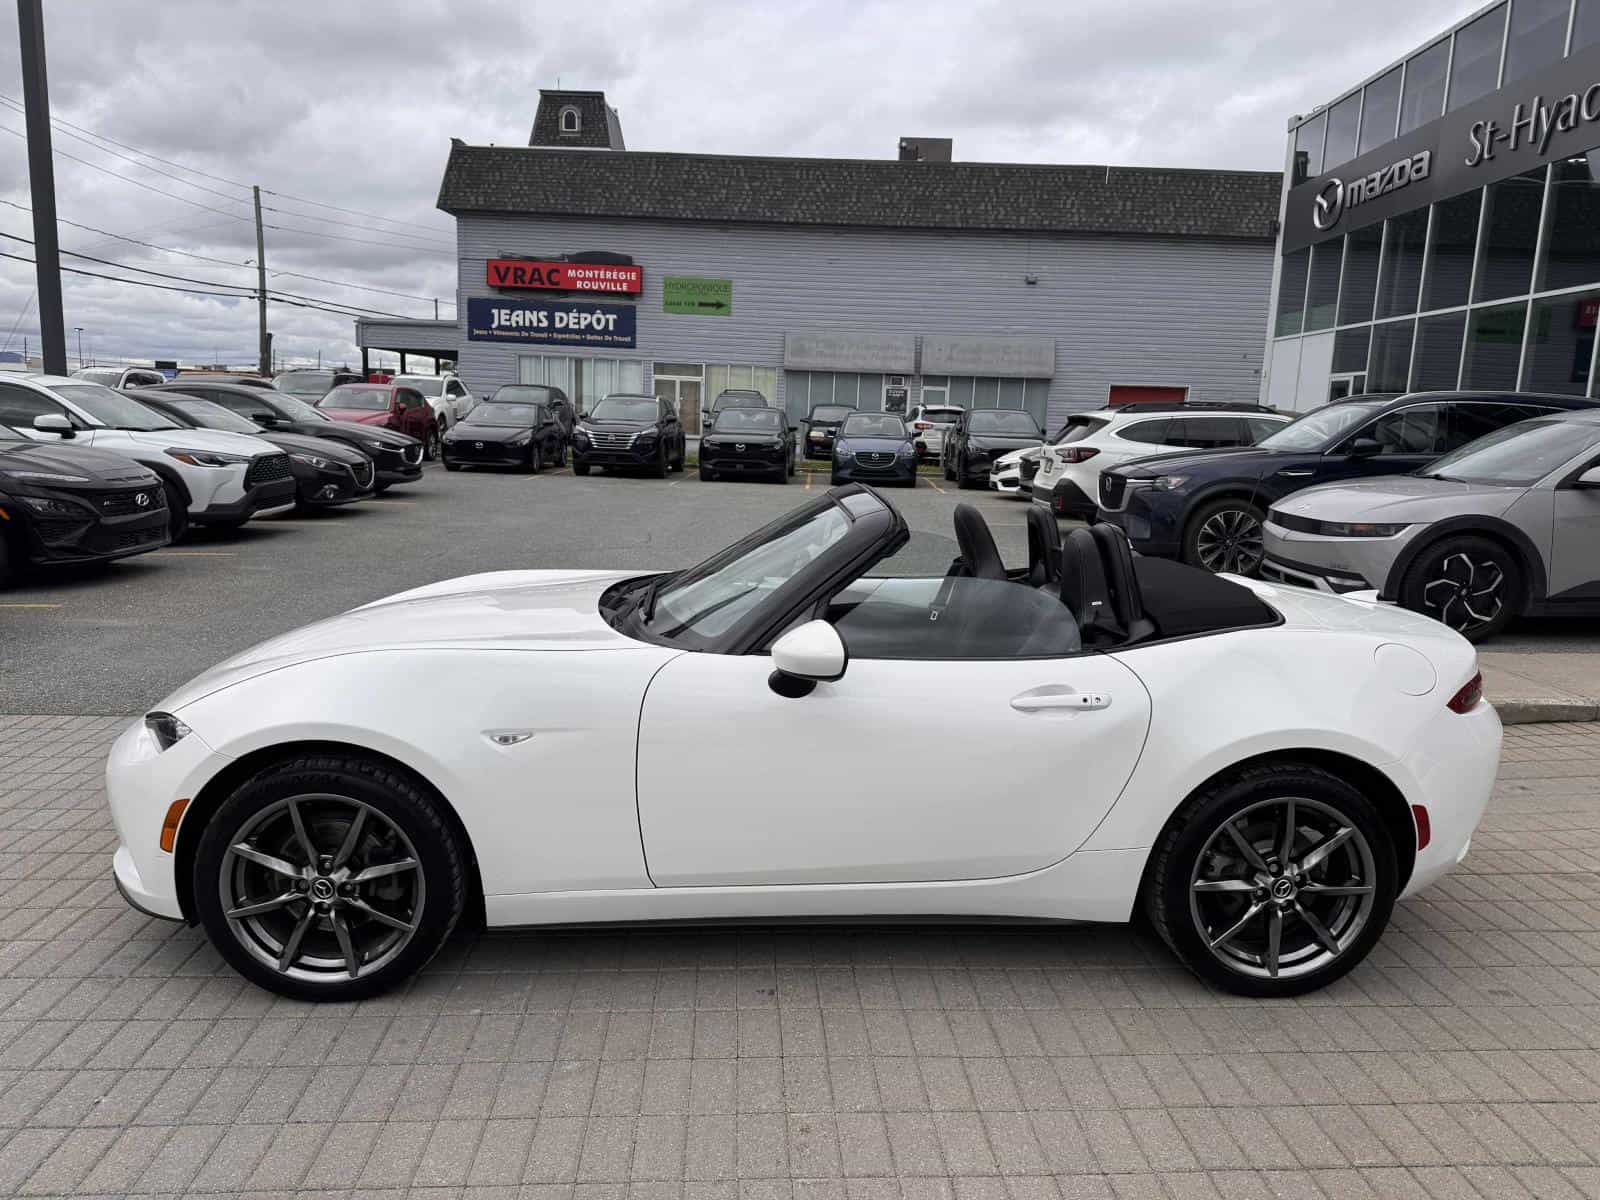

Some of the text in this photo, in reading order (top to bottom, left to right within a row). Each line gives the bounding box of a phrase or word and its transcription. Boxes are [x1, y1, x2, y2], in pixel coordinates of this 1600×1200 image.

[493, 265, 561, 287] VRAC
[567, 267, 638, 281] MONTÉRÉGIE
[576, 280, 629, 292] ROUVILLE
[490, 308, 618, 331] JEANS DÉPÔT
